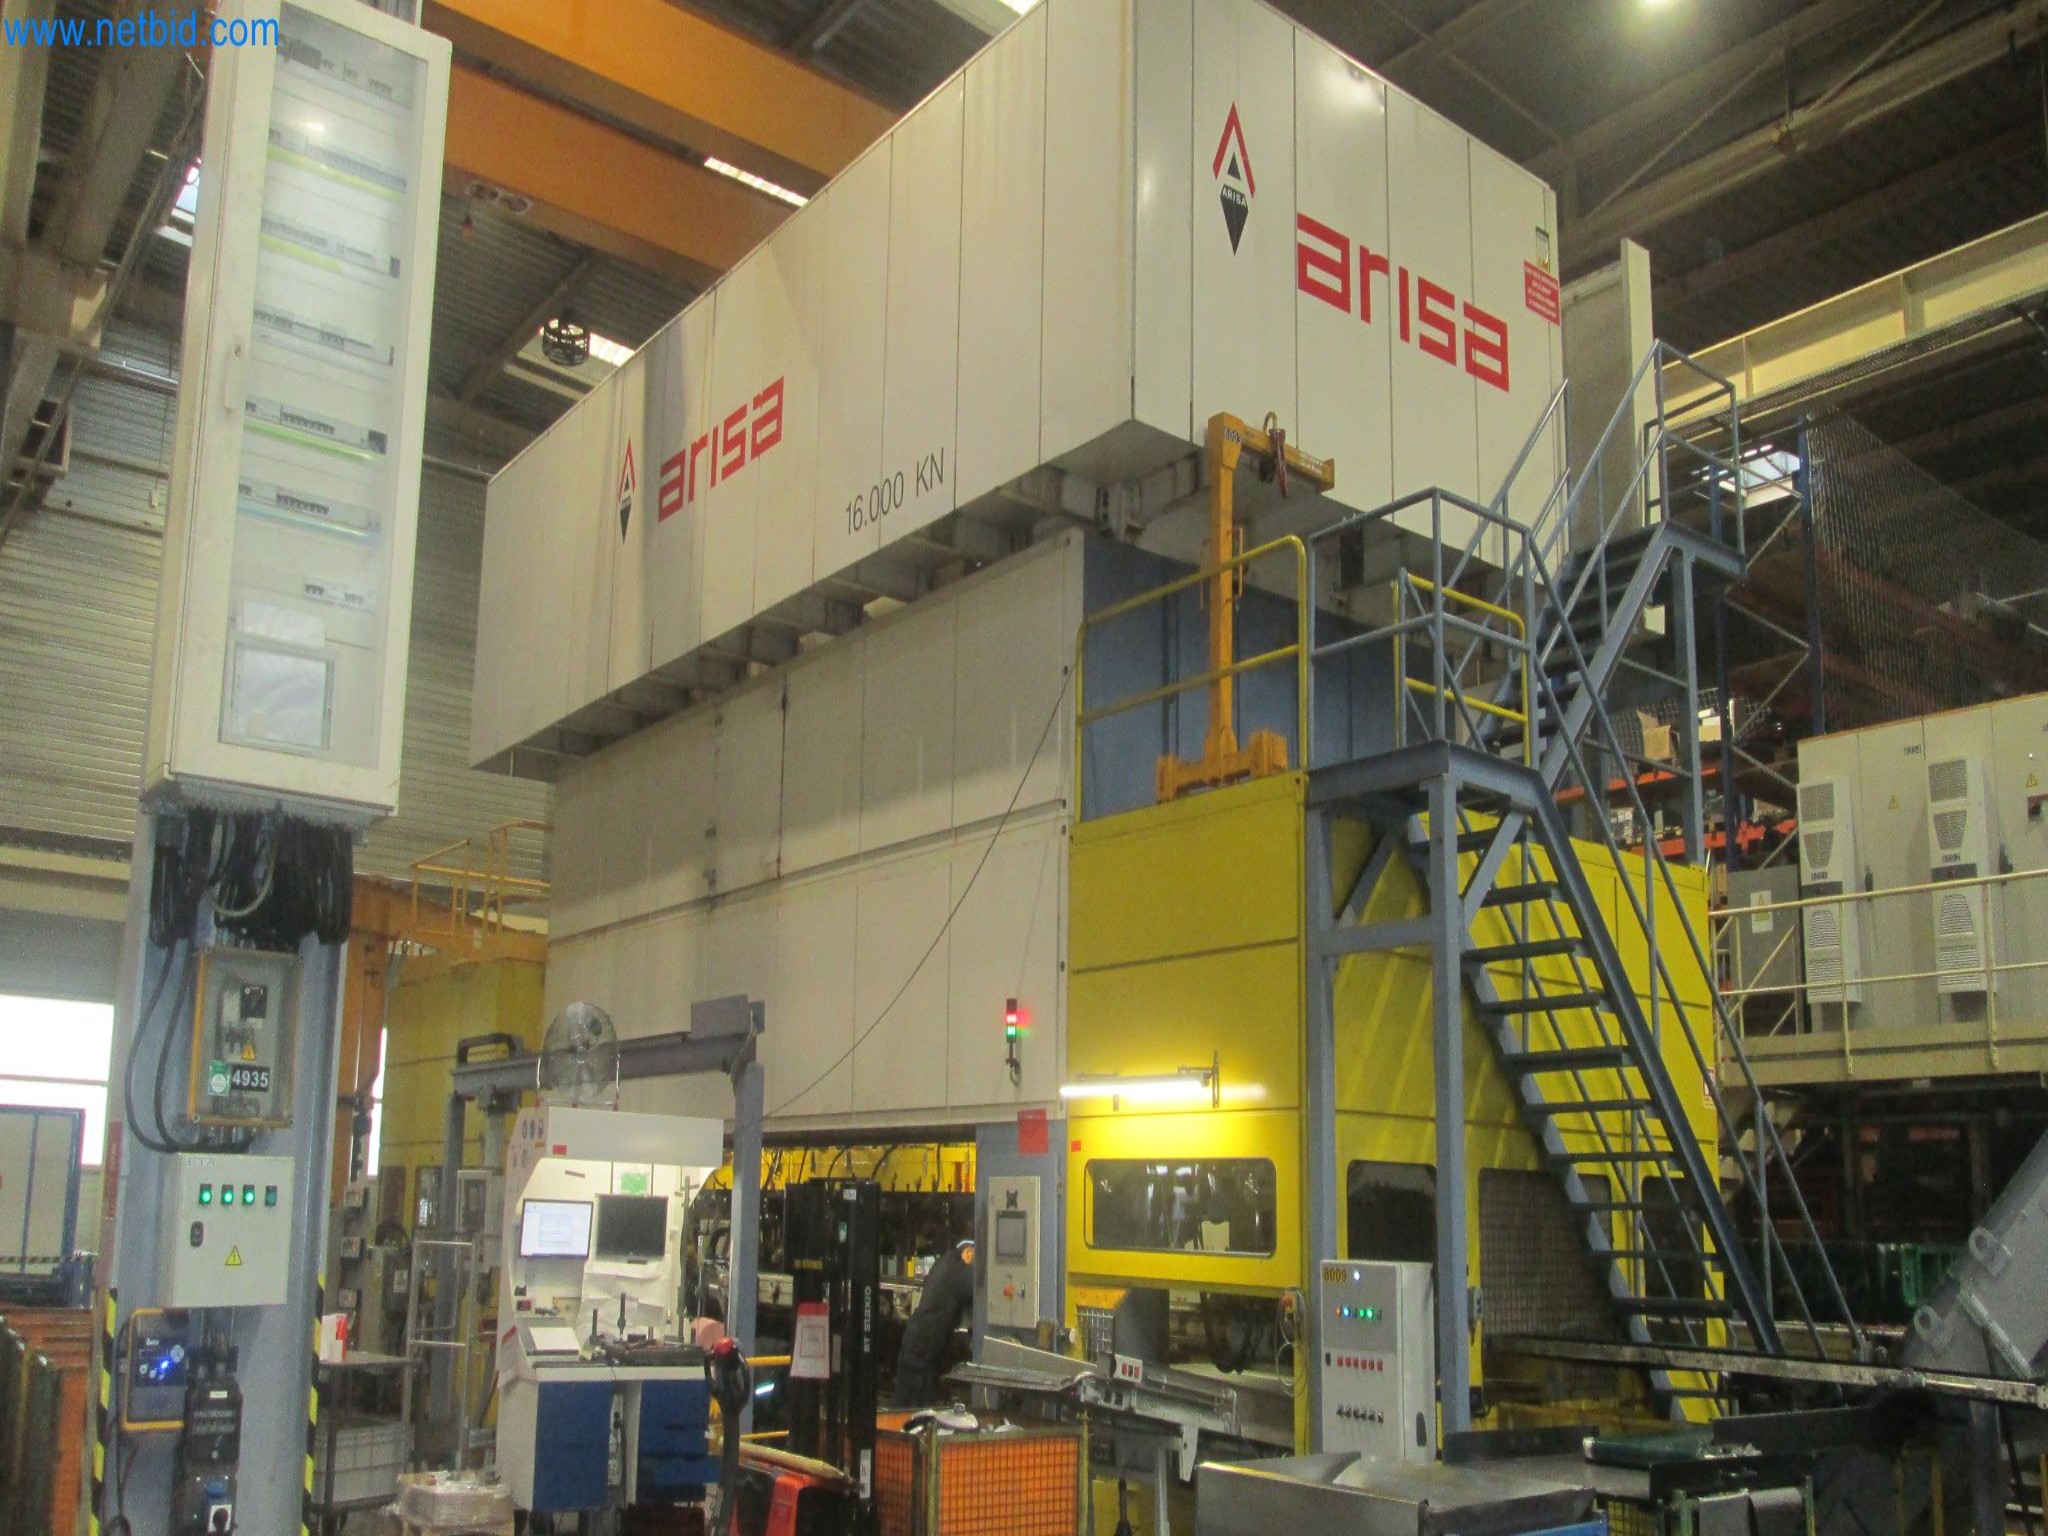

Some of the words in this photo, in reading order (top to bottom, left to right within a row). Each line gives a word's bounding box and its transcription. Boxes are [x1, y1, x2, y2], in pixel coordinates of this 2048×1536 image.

[1221, 186, 1248, 209] ARISA
[1296, 211, 1510, 394] arisa
[657, 378, 785, 523] arisa
[845, 470, 905, 537] 16.000
[915, 446, 945, 498] KN
[232, 1069, 269, 1088] 4935
